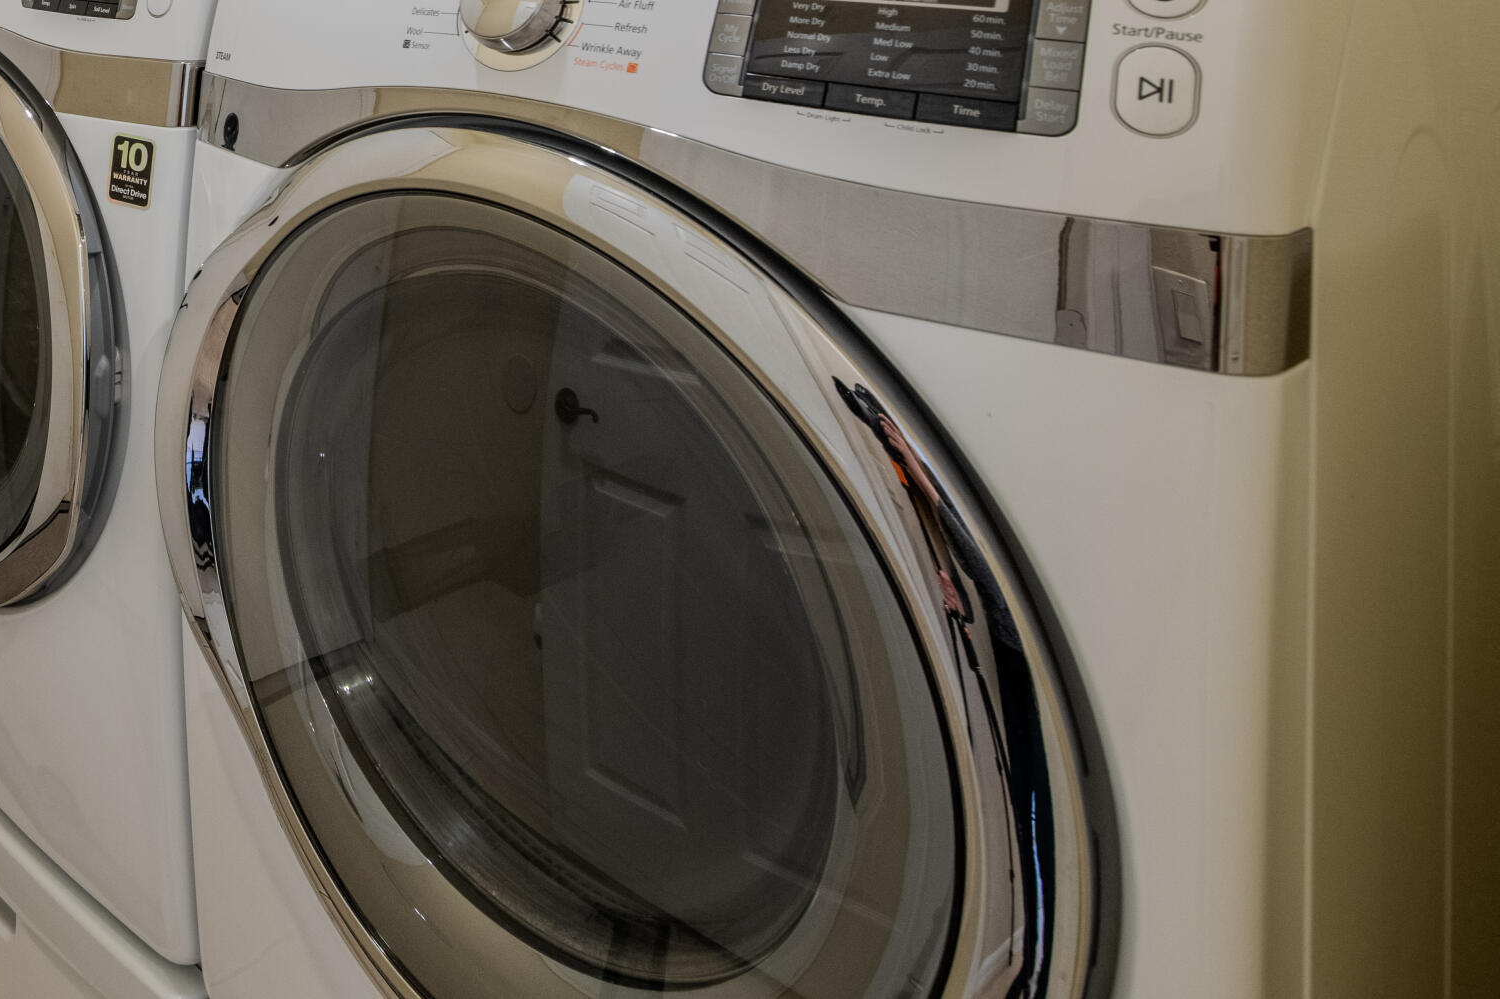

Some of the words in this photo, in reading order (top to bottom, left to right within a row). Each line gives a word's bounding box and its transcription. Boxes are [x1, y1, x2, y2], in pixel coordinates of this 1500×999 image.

[618, 0, 632, 9] Air
[634, 1, 655, 10] Fluff
[792, 2, 810, 11] Very
[811, 3, 826, 13] Dry
[1046, 1, 1084, 14] Adjust
[412, 7, 440, 16] Delicates
[877, 6, 899, 18] High
[789, 16, 810, 25] More
[811, 17, 826, 27] Dry
[972, 14, 985, 24] 60
[1049, 13, 1078, 24] Time
[406, 27, 424, 35] Wool
[613, 23, 649, 33] Refresh
[874, 21, 911, 32] Medium
[787, 31, 816, 41] Normal
[817, 32, 831, 43] Dry
[970, 30, 984, 39] 50
[1112, 23, 1205, 43] Start/Pause
[871, 37, 892, 47] Med
[894, 39, 915, 49] Low
[581, 43, 613, 55] Wrinkle
[615, 46, 643, 59] Away
[784, 46, 801, 54] Less
[802, 47, 817, 57] Dry
[967, 47, 981, 56] 40
[1040, 48, 1077, 59] Mixed
[869, 53, 891, 62] Low
[573, 57, 598, 67] Steam
[600, 60, 625, 71] Cycles
[781, 60, 804, 71] Damp
[805, 62, 820, 73] Dry
[965, 62, 978, 72] 30
[1042, 60, 1073, 70] Load
[867, 68, 890, 79] Extra
[892, 71, 912, 81] Low
[1045, 71, 1069, 81] Bell
[761, 82, 778, 94] Dry
[780, 83, 805, 96] Level
[963, 79, 976, 89] 20
[855, 93, 887, 108] Temp.
[1035, 99, 1070, 112] Delay
[952, 104, 981, 118] Time
[1036, 111, 1067, 123] Start
[118, 141, 148, 171] 10
[113, 173, 148, 186] WARRANTY
[111, 185, 130, 195] Direct
[130, 188, 147, 199] Drive
